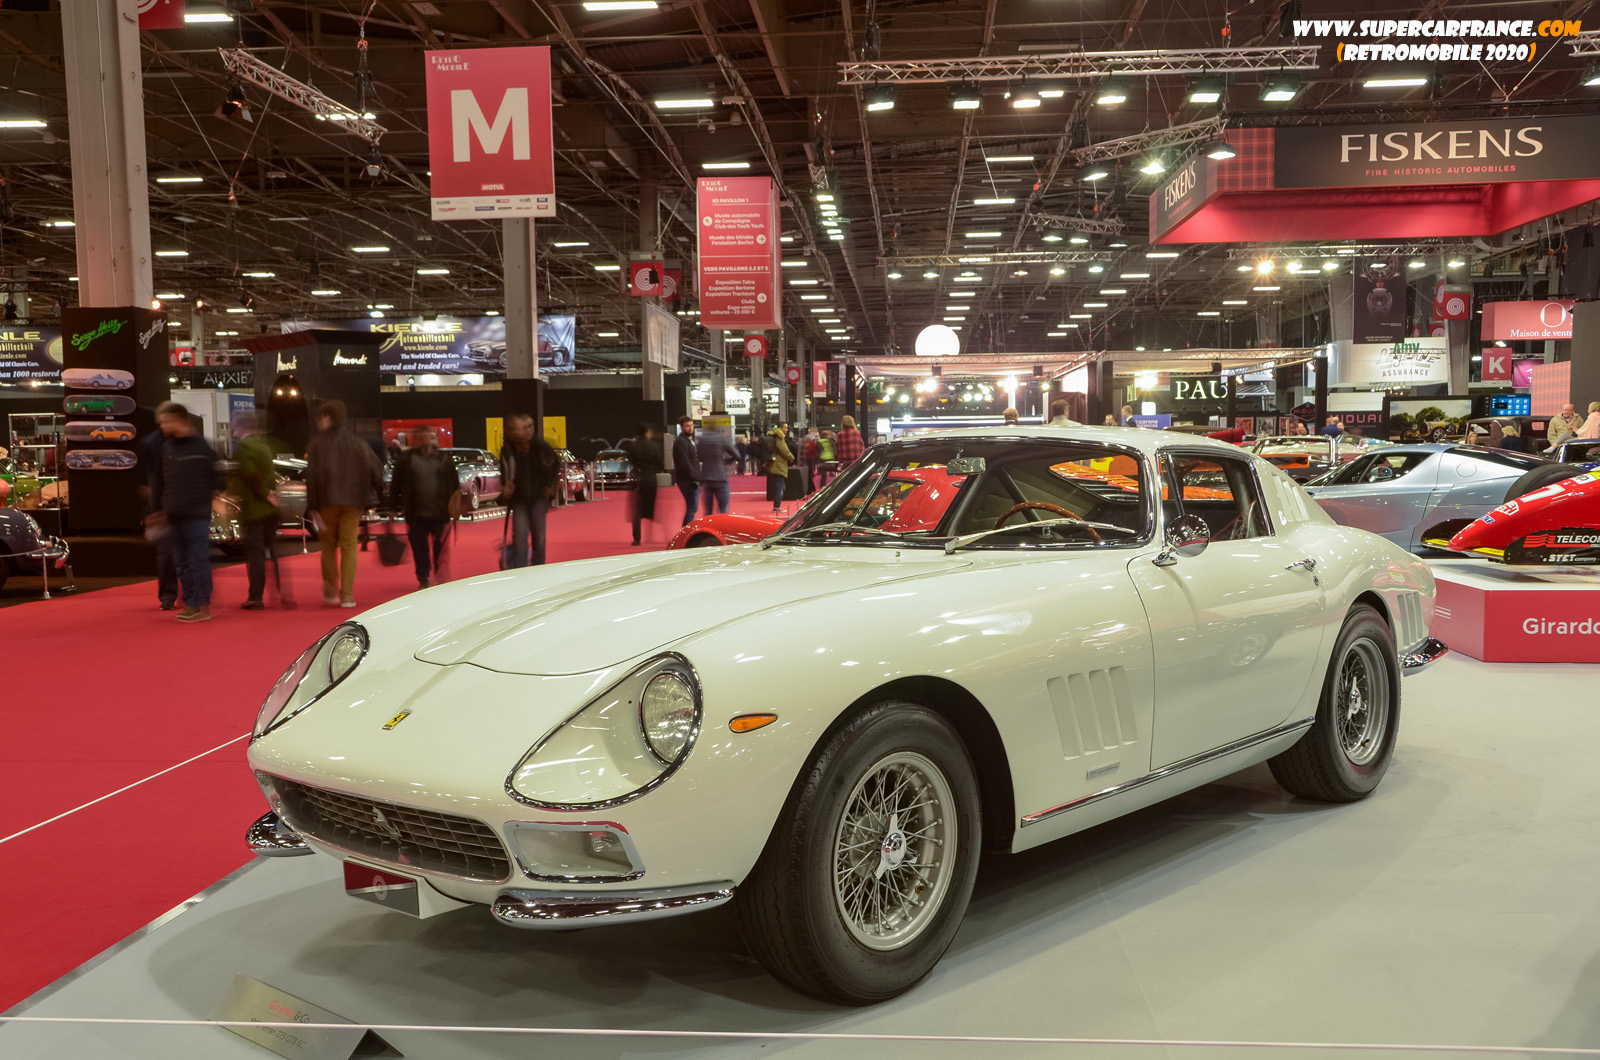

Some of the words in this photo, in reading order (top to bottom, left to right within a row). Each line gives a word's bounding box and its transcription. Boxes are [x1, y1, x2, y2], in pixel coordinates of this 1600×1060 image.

[451, 87, 531, 162] M
[1340, 126, 1544, 163] FISKENS
[1394, 167, 1442, 175] HISTORIC
[1447, 165, 1516, 174] AUTOMOBILES
[1164, 160, 1196, 211] FISKENS
[370, 322, 462, 333] KIENLE
[1510, 329, 1540, 337] Maison
[403, 362, 416, 370] and
[418, 362, 441, 370] traded
[1489, 356, 1505, 373] K
[1382, 369, 1429, 377] ASSURANCE
[1175, 380, 1245, 400] PAU
[1556, 535, 1600, 543] TELECO
[269, 1000, 296, 1018] Girardo
